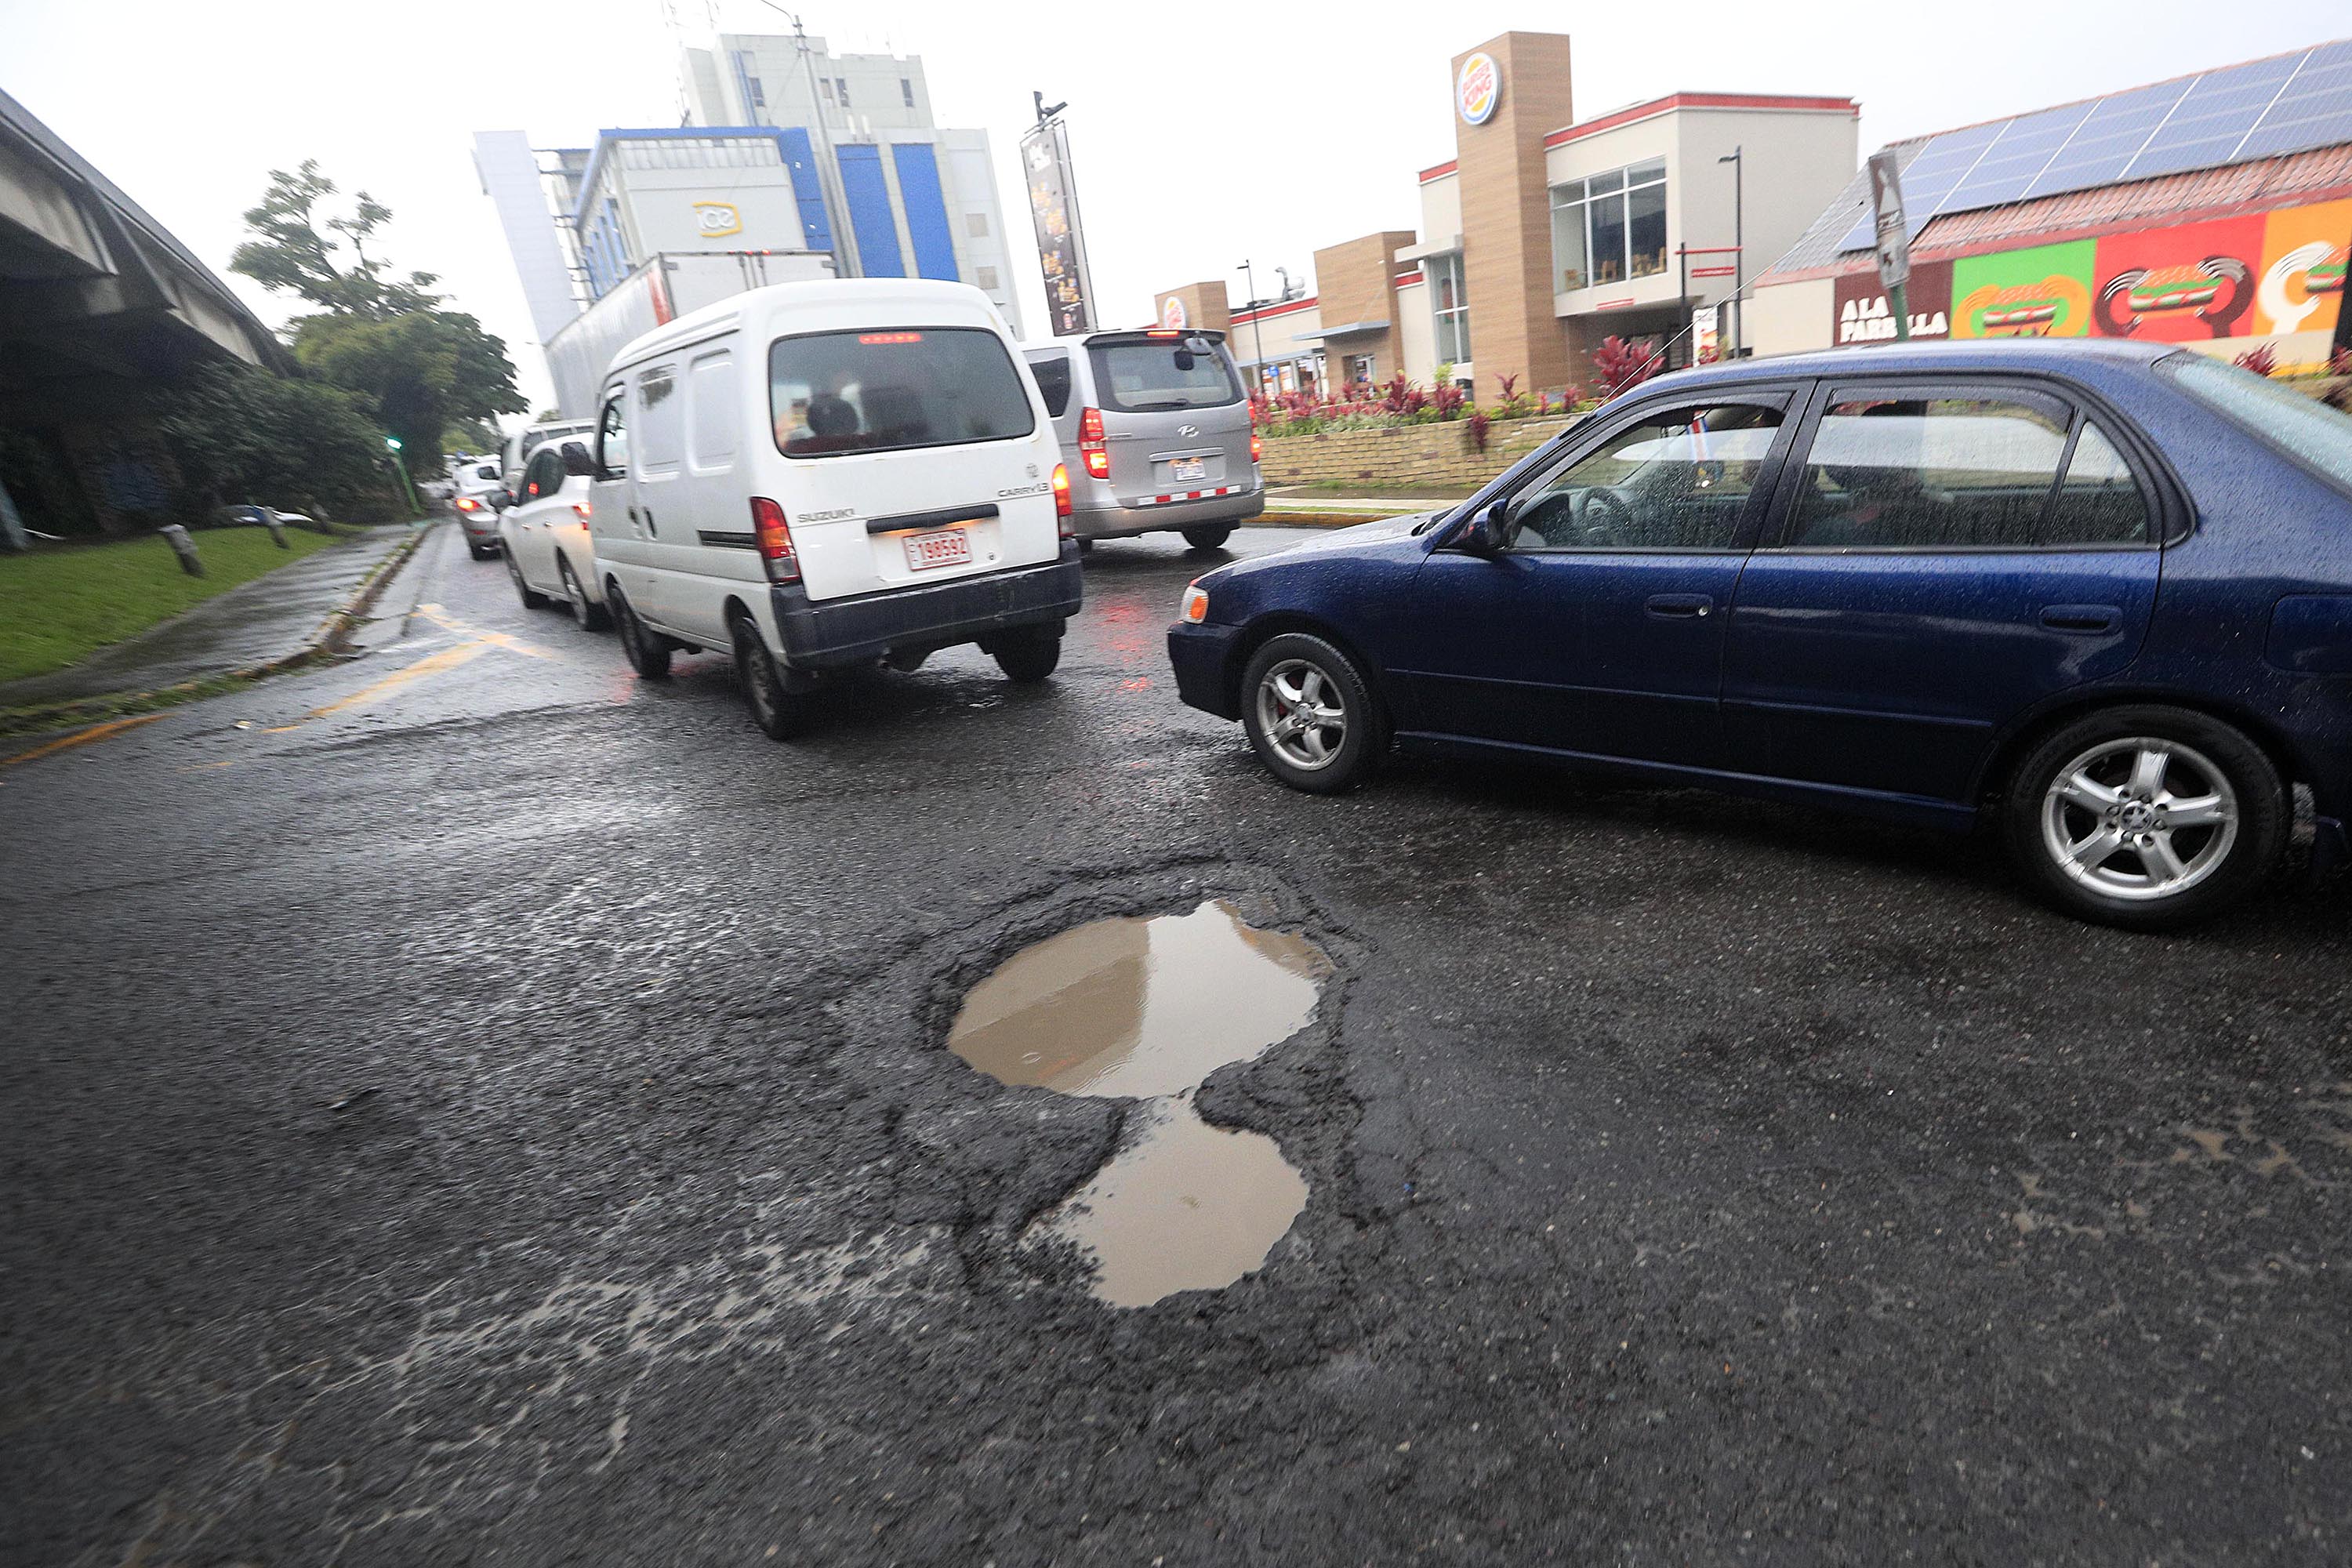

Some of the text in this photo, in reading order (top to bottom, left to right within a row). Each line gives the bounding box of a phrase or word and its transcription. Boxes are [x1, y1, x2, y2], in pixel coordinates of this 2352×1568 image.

[1840, 311, 1948, 343] PARRLLA
[998, 486, 1036, 497] CARRY
[797, 508, 854, 523] SUZUKI
